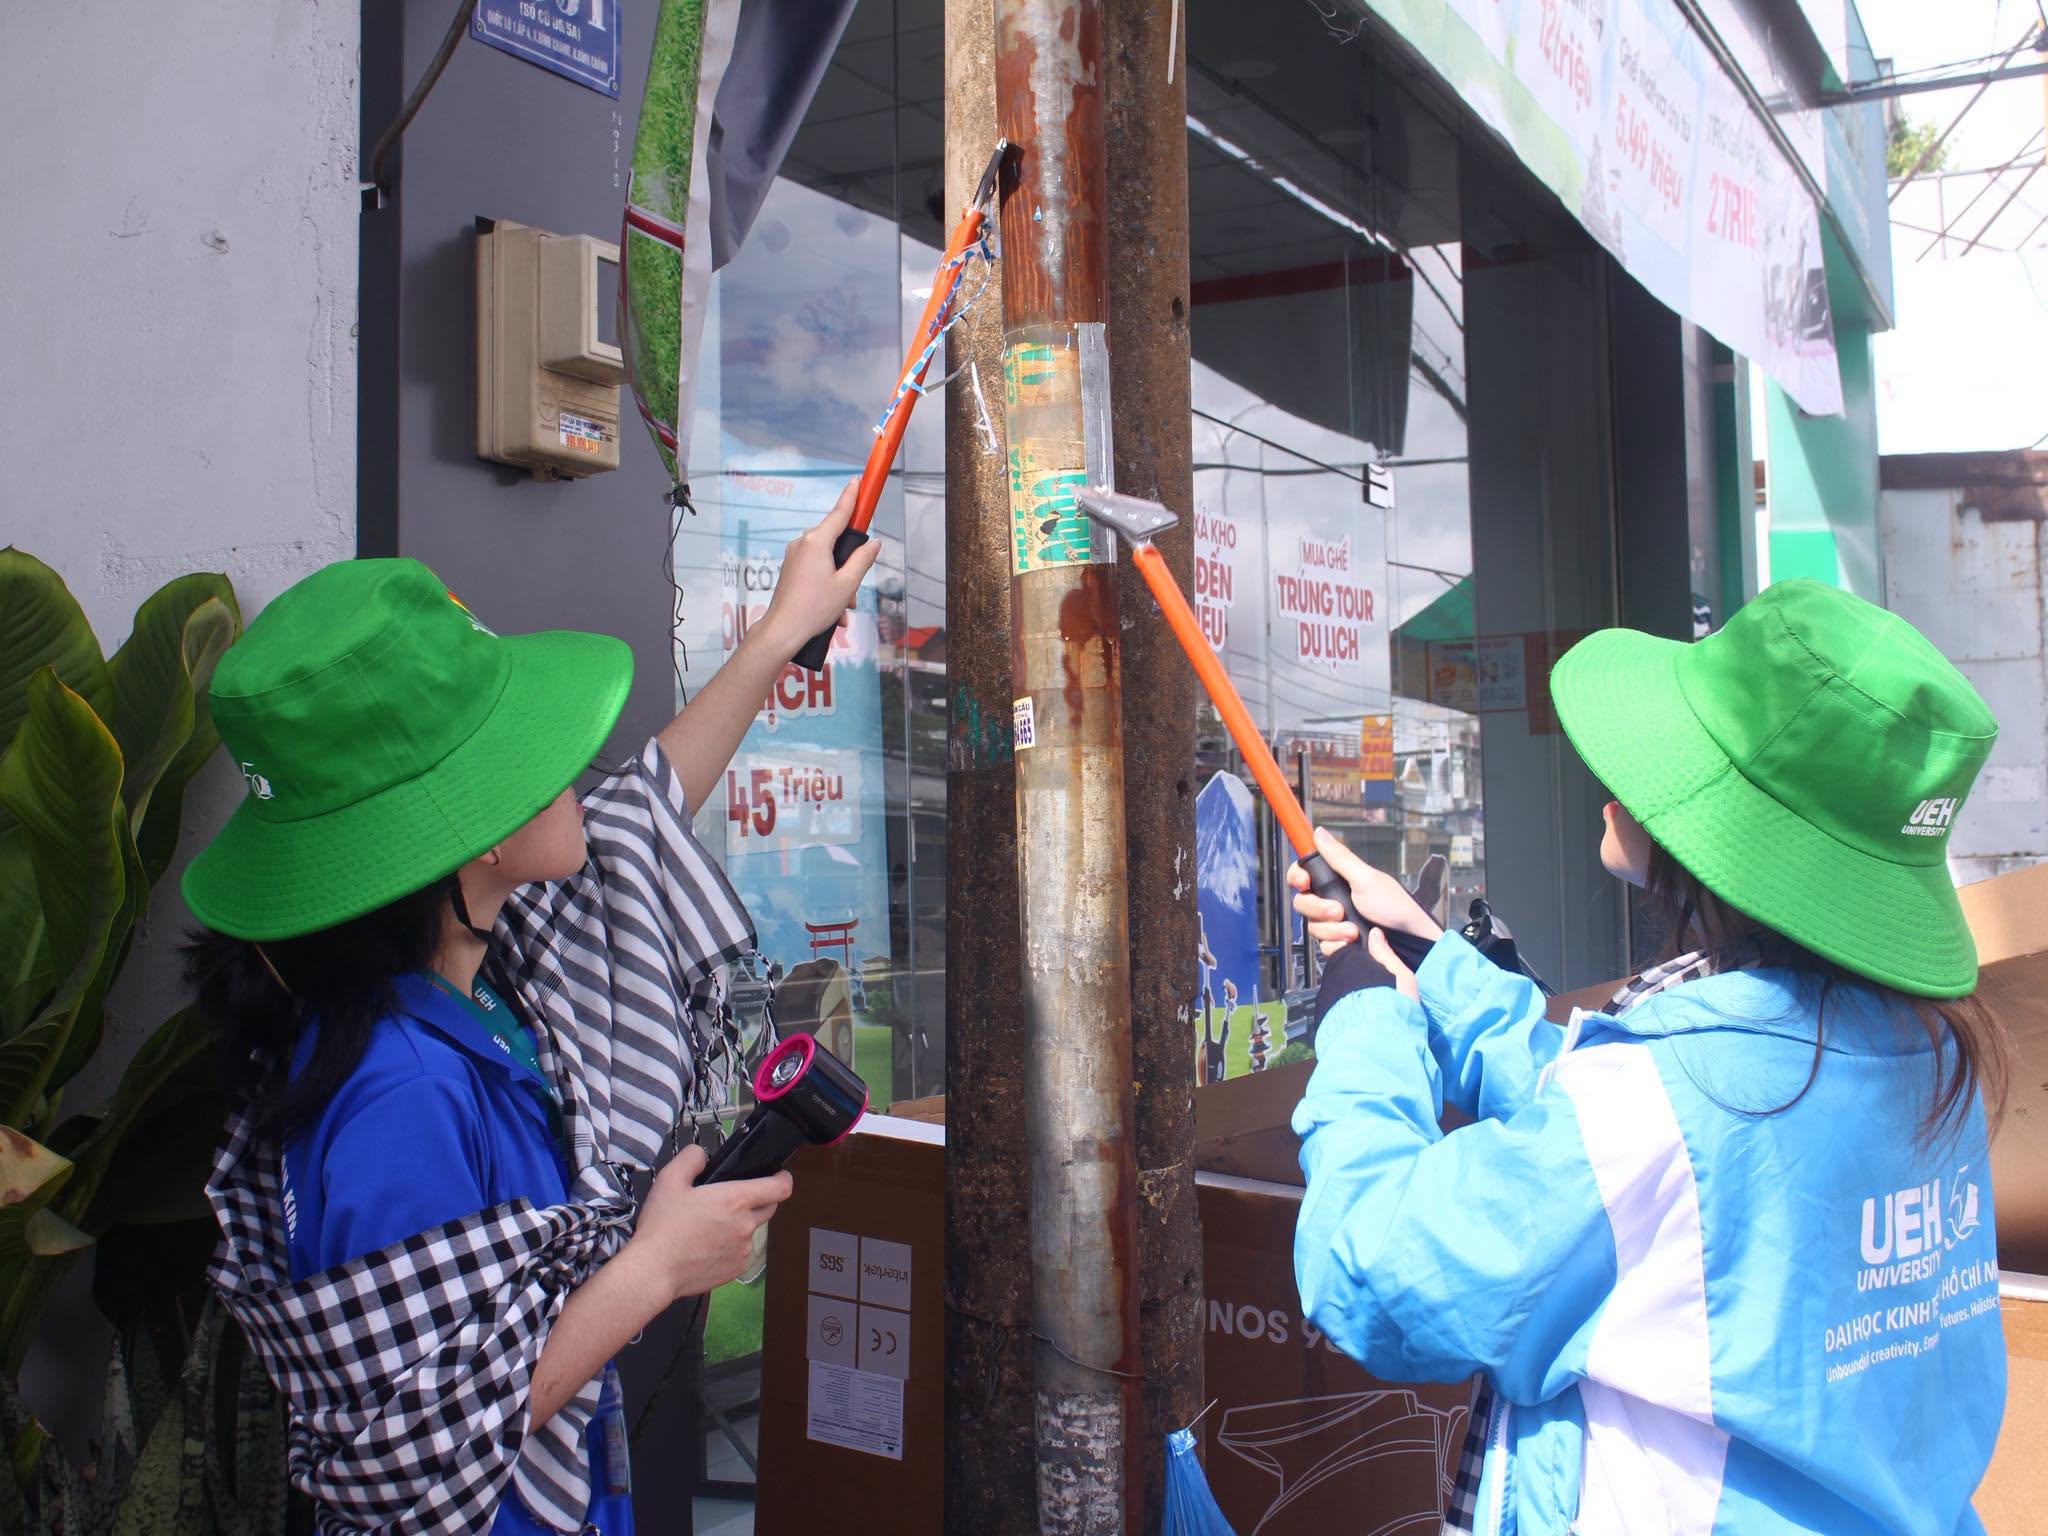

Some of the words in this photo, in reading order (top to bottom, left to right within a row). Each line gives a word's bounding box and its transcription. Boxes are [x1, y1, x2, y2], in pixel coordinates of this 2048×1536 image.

[1211, 518, 1236, 549] KHO
[1303, 541, 1325, 567] MUA
[1196, 546, 1232, 601] ĐẾN
[1278, 569, 1334, 616] TRÚNG
[1335, 585, 1374, 621] TOUR
[1300, 622, 1321, 658] DU
[1325, 625, 1358, 669] LỊCH
[727, 769, 776, 837] 45
[778, 767, 843, 811] Triệu
[1909, 797, 1957, 825] UEH
[1901, 825, 1946, 837] UNIVERSITY
[475, 987, 497, 1011] UEH
[1860, 1178, 1942, 1264] UEH
[820, 1254, 844, 1272] SGS
[1857, 1248, 1942, 1292] UNIVERSITY
[1210, 1299, 1289, 1344] NOS
[1825, 1322, 1851, 1352] ĐẠI
[1852, 1311, 1882, 1341] HỌC
[1886, 1301, 1930, 1331] KINH
[1941, 1266, 1959, 1300] HỒ
[1960, 1259, 1982, 1291] CHÍ
[1871, 1340, 1922, 1364] creativity.
